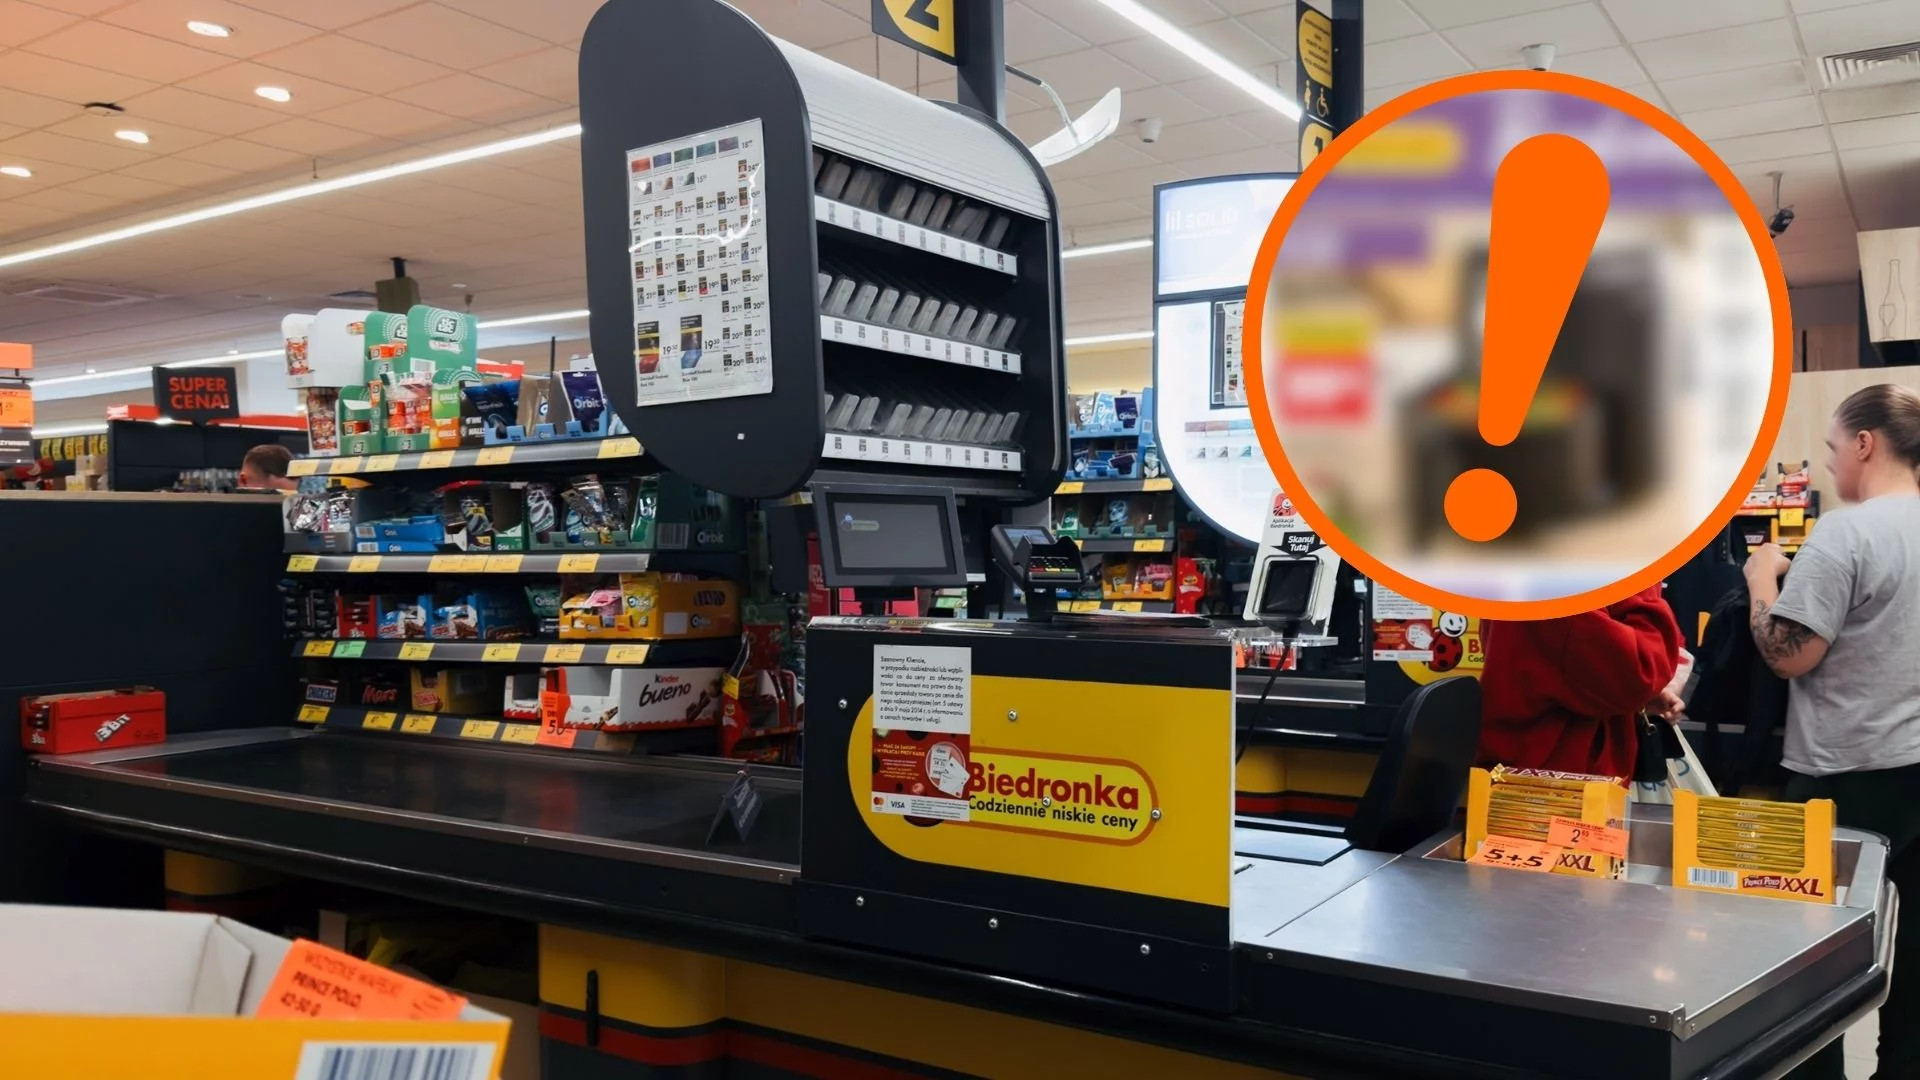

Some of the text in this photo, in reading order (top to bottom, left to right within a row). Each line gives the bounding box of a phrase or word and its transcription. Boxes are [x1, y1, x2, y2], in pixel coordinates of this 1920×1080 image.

[168, 376, 227, 392] SUPER
[171, 393, 230, 409] CENA!
[1287, 535, 1315, 544] Skanuj
[1290, 543, 1309, 552] Tutaj
[654, 674, 680, 684] kinder
[362, 684, 398, 704] Mars
[638, 682, 692, 708] bueno
[968, 762, 1139, 811] Biedronka
[890, 801, 905, 809] VISA
[968, 795, 1046, 819] Codziennie
[1052, 806, 1096, 825] niskie
[1101, 813, 1138, 832] ceny
[1557, 854, 1596, 873] XXL
[1781, 877, 1824, 897] XXL
